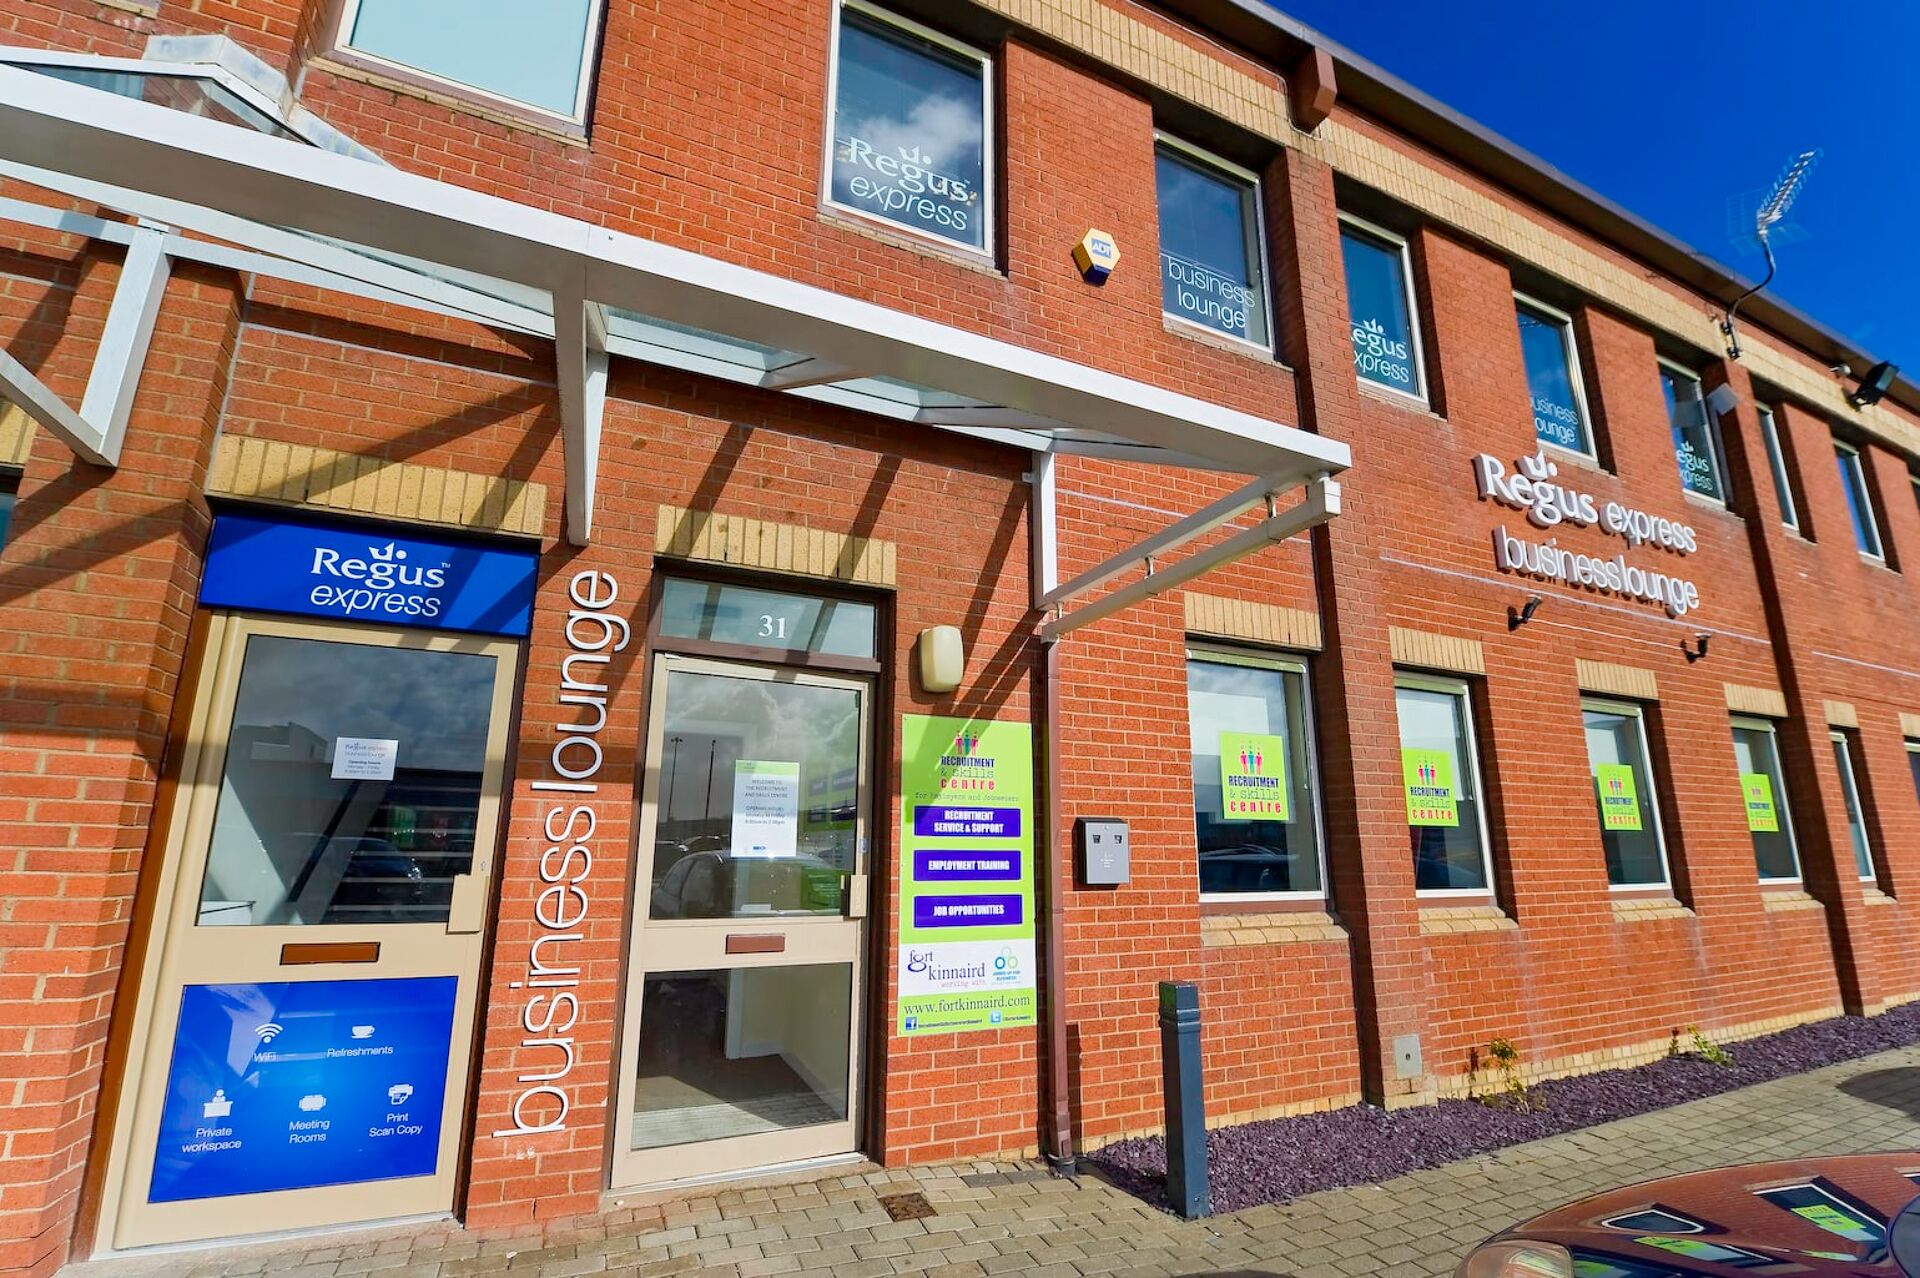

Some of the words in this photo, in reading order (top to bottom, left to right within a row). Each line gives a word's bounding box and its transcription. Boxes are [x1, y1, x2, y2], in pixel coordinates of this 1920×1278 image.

[849, 137, 969, 201] Regus
[850, 176, 968, 230] express
[1092, 239, 1111, 257] ADT
[1168, 257, 1256, 308] business
[1177, 284, 1246, 329] lounge
[1351, 328, 1407, 360] egus
[1353, 351, 1409, 383] xpress
[1530, 397, 1579, 425] usiness
[1535, 417, 1576, 444] ounge
[1676, 450, 1710, 473] egus
[1477, 453, 1599, 525] Regus
[1603, 502, 1698, 553] express
[310, 547, 447, 590] Regus
[310, 585, 441, 617] express
[758, 615, 786, 639] 31
[941, 755, 995, 768] RECRUITMENT
[952, 767, 995, 778] skills
[941, 779, 995, 790] centre
[1228, 775, 1279, 788] RECRUITMENT
[1241, 788, 1280, 800] skills
[1410, 786, 1449, 797] RECRUITMENT
[1230, 801, 1281, 813] centre
[944, 810, 994, 820] RECRUITMENT
[1412, 809, 1453, 819] centre
[934, 822, 964, 832] SERVICE
[965, 824, 971, 832] &
[971, 823, 1004, 833] SUPPORT
[928, 860, 976, 870] EMPLOYMENT
[977, 860, 1010, 870] TRAINING
[933, 905, 949, 916] JOB
[949, 904, 1004, 915] OPPORTUNITIES
[928, 963, 985, 980] kinnaird
[904, 995, 1031, 1015] www.fortkinnaird.com
[253, 1051, 278, 1063] WiFi
[327, 1045, 394, 1058] Refreshments
[387, 1112, 409, 1123] Print
[195, 1126, 233, 1138] Private
[288, 1119, 330, 1132] Meeting
[369, 1126, 395, 1138] Scan
[397, 1124, 423, 1137] Copy
[289, 1133, 326, 1144] Rooms
[182, 1140, 242, 1153] workspace
